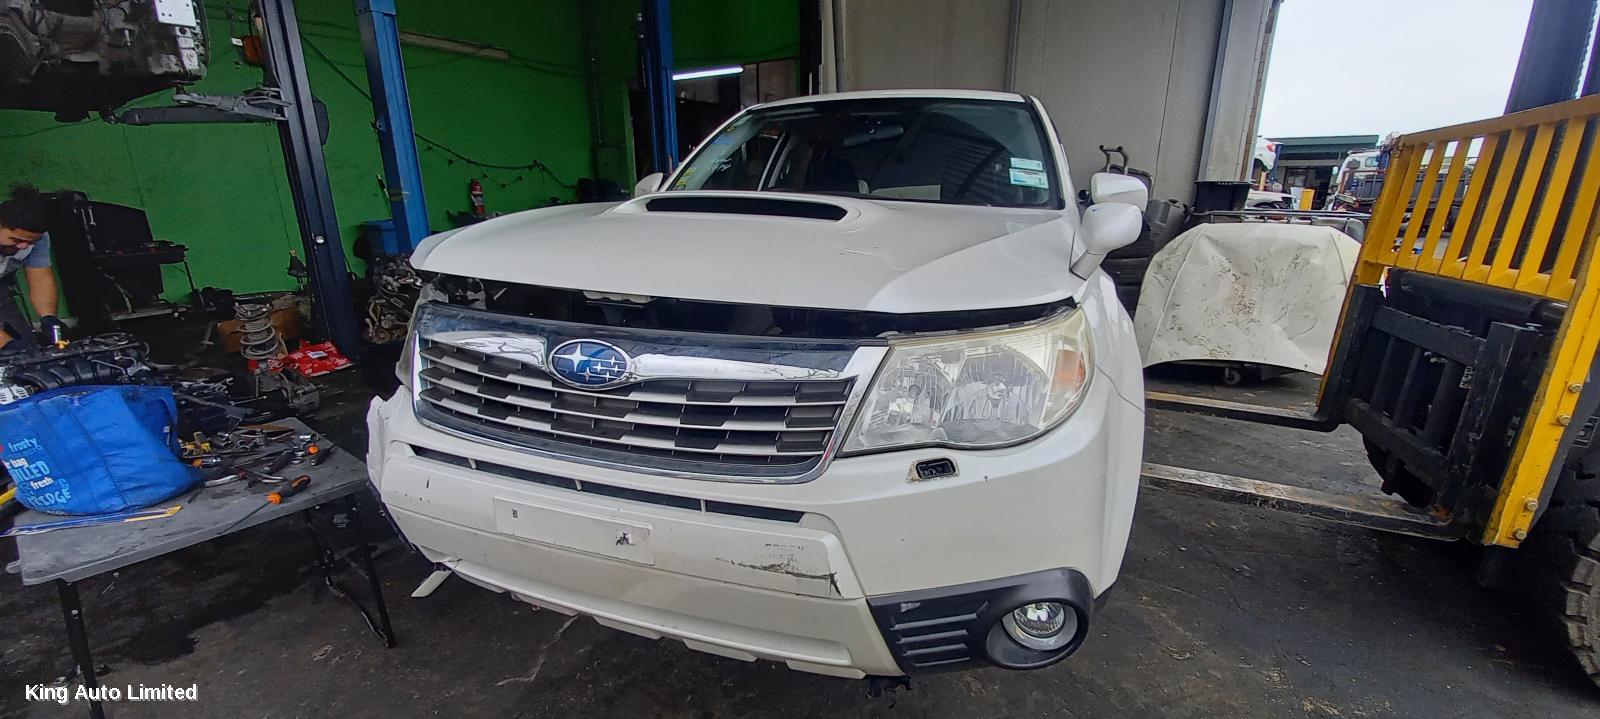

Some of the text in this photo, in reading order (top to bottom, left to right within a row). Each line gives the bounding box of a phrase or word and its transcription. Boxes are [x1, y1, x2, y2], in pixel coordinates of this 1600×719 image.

[8, 437, 38, 452] frosty
[10, 458, 29, 469] bag
[30, 476, 54, 490] fresh
